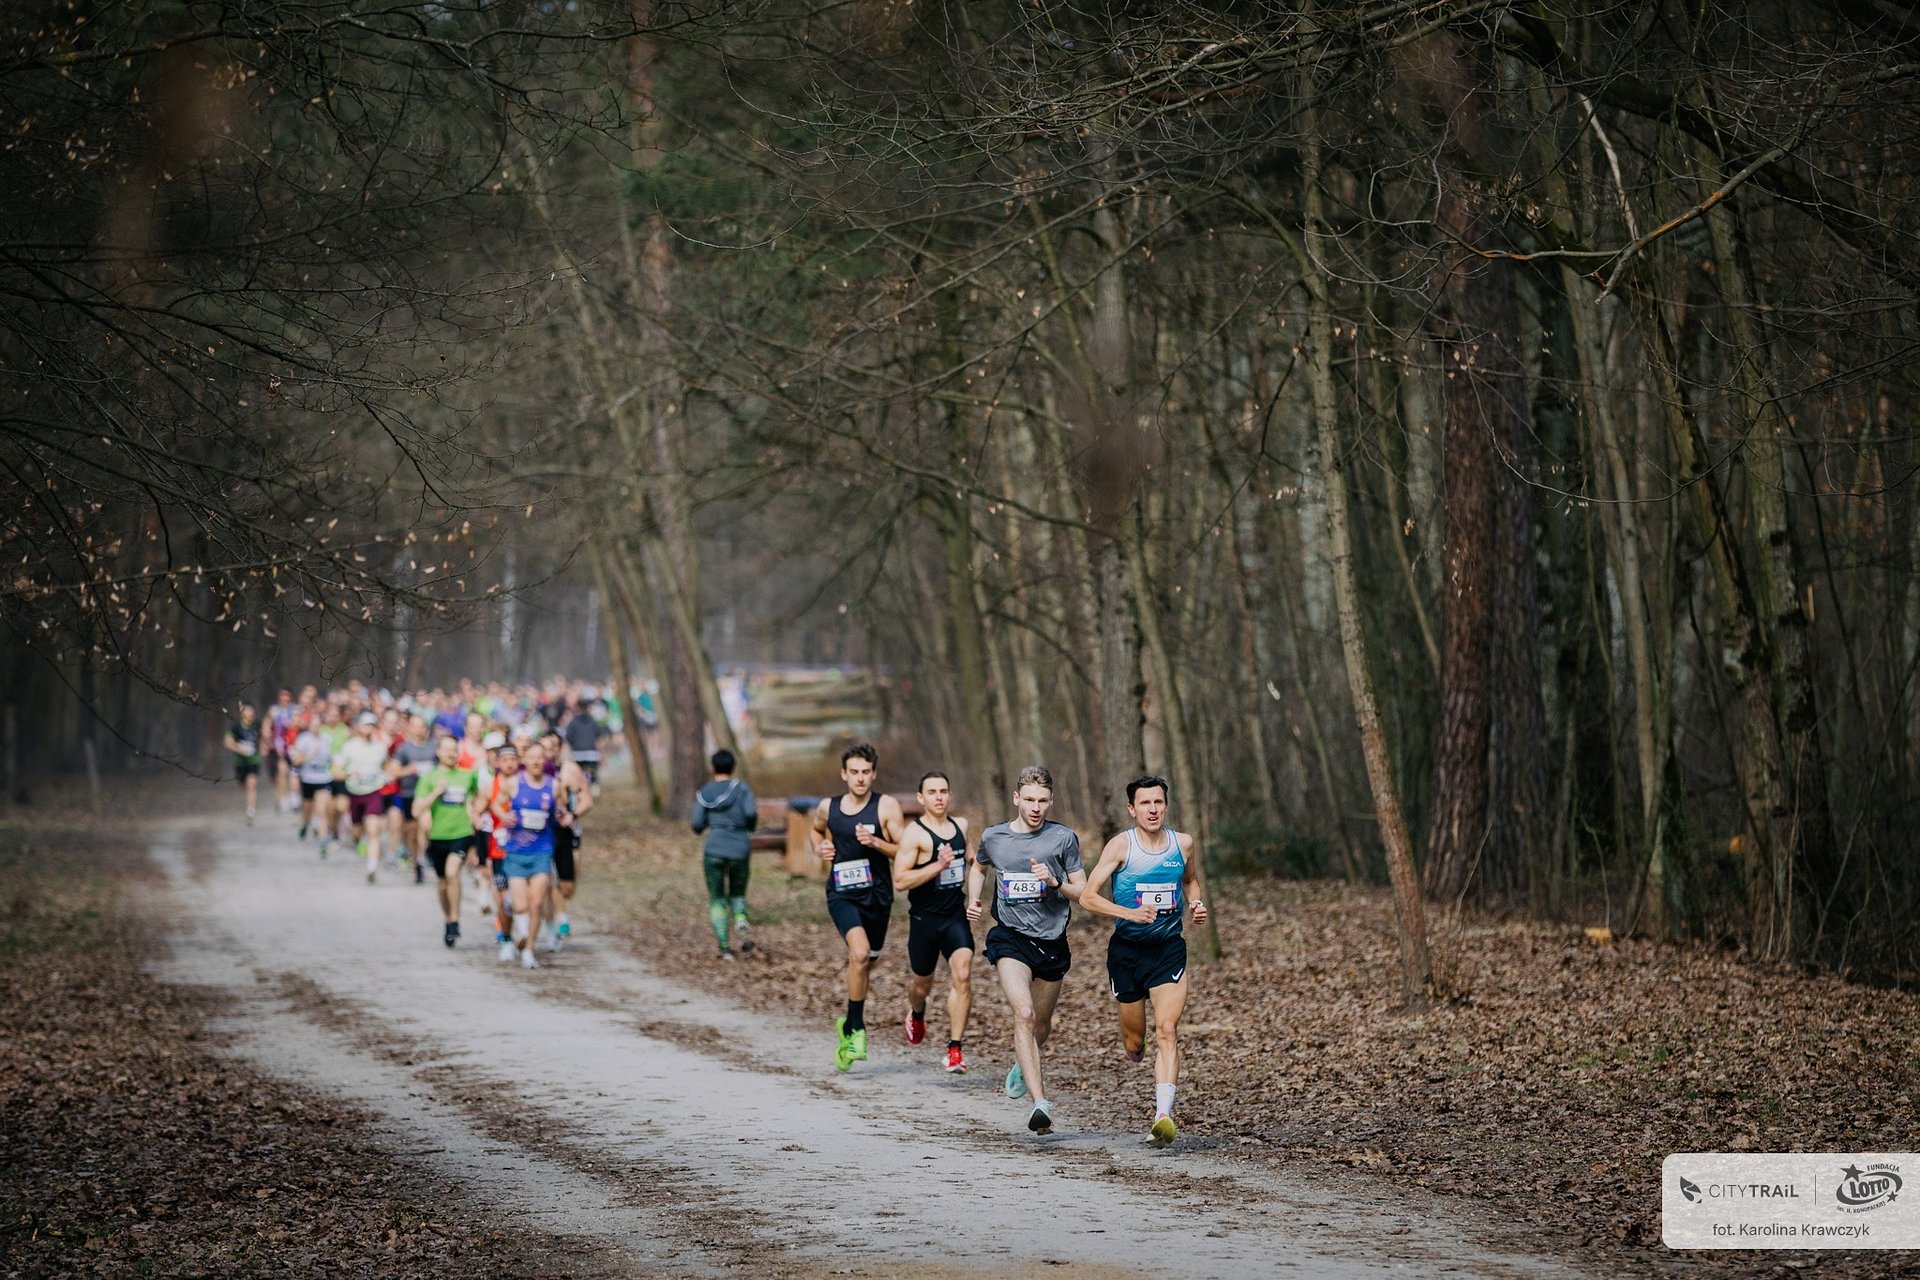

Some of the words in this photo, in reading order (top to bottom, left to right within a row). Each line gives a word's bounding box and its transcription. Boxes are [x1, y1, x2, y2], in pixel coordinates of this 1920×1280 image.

[843, 869, 862, 879] 482
[1013, 882, 1036, 893] 483
[1154, 893, 1162, 903] 6
